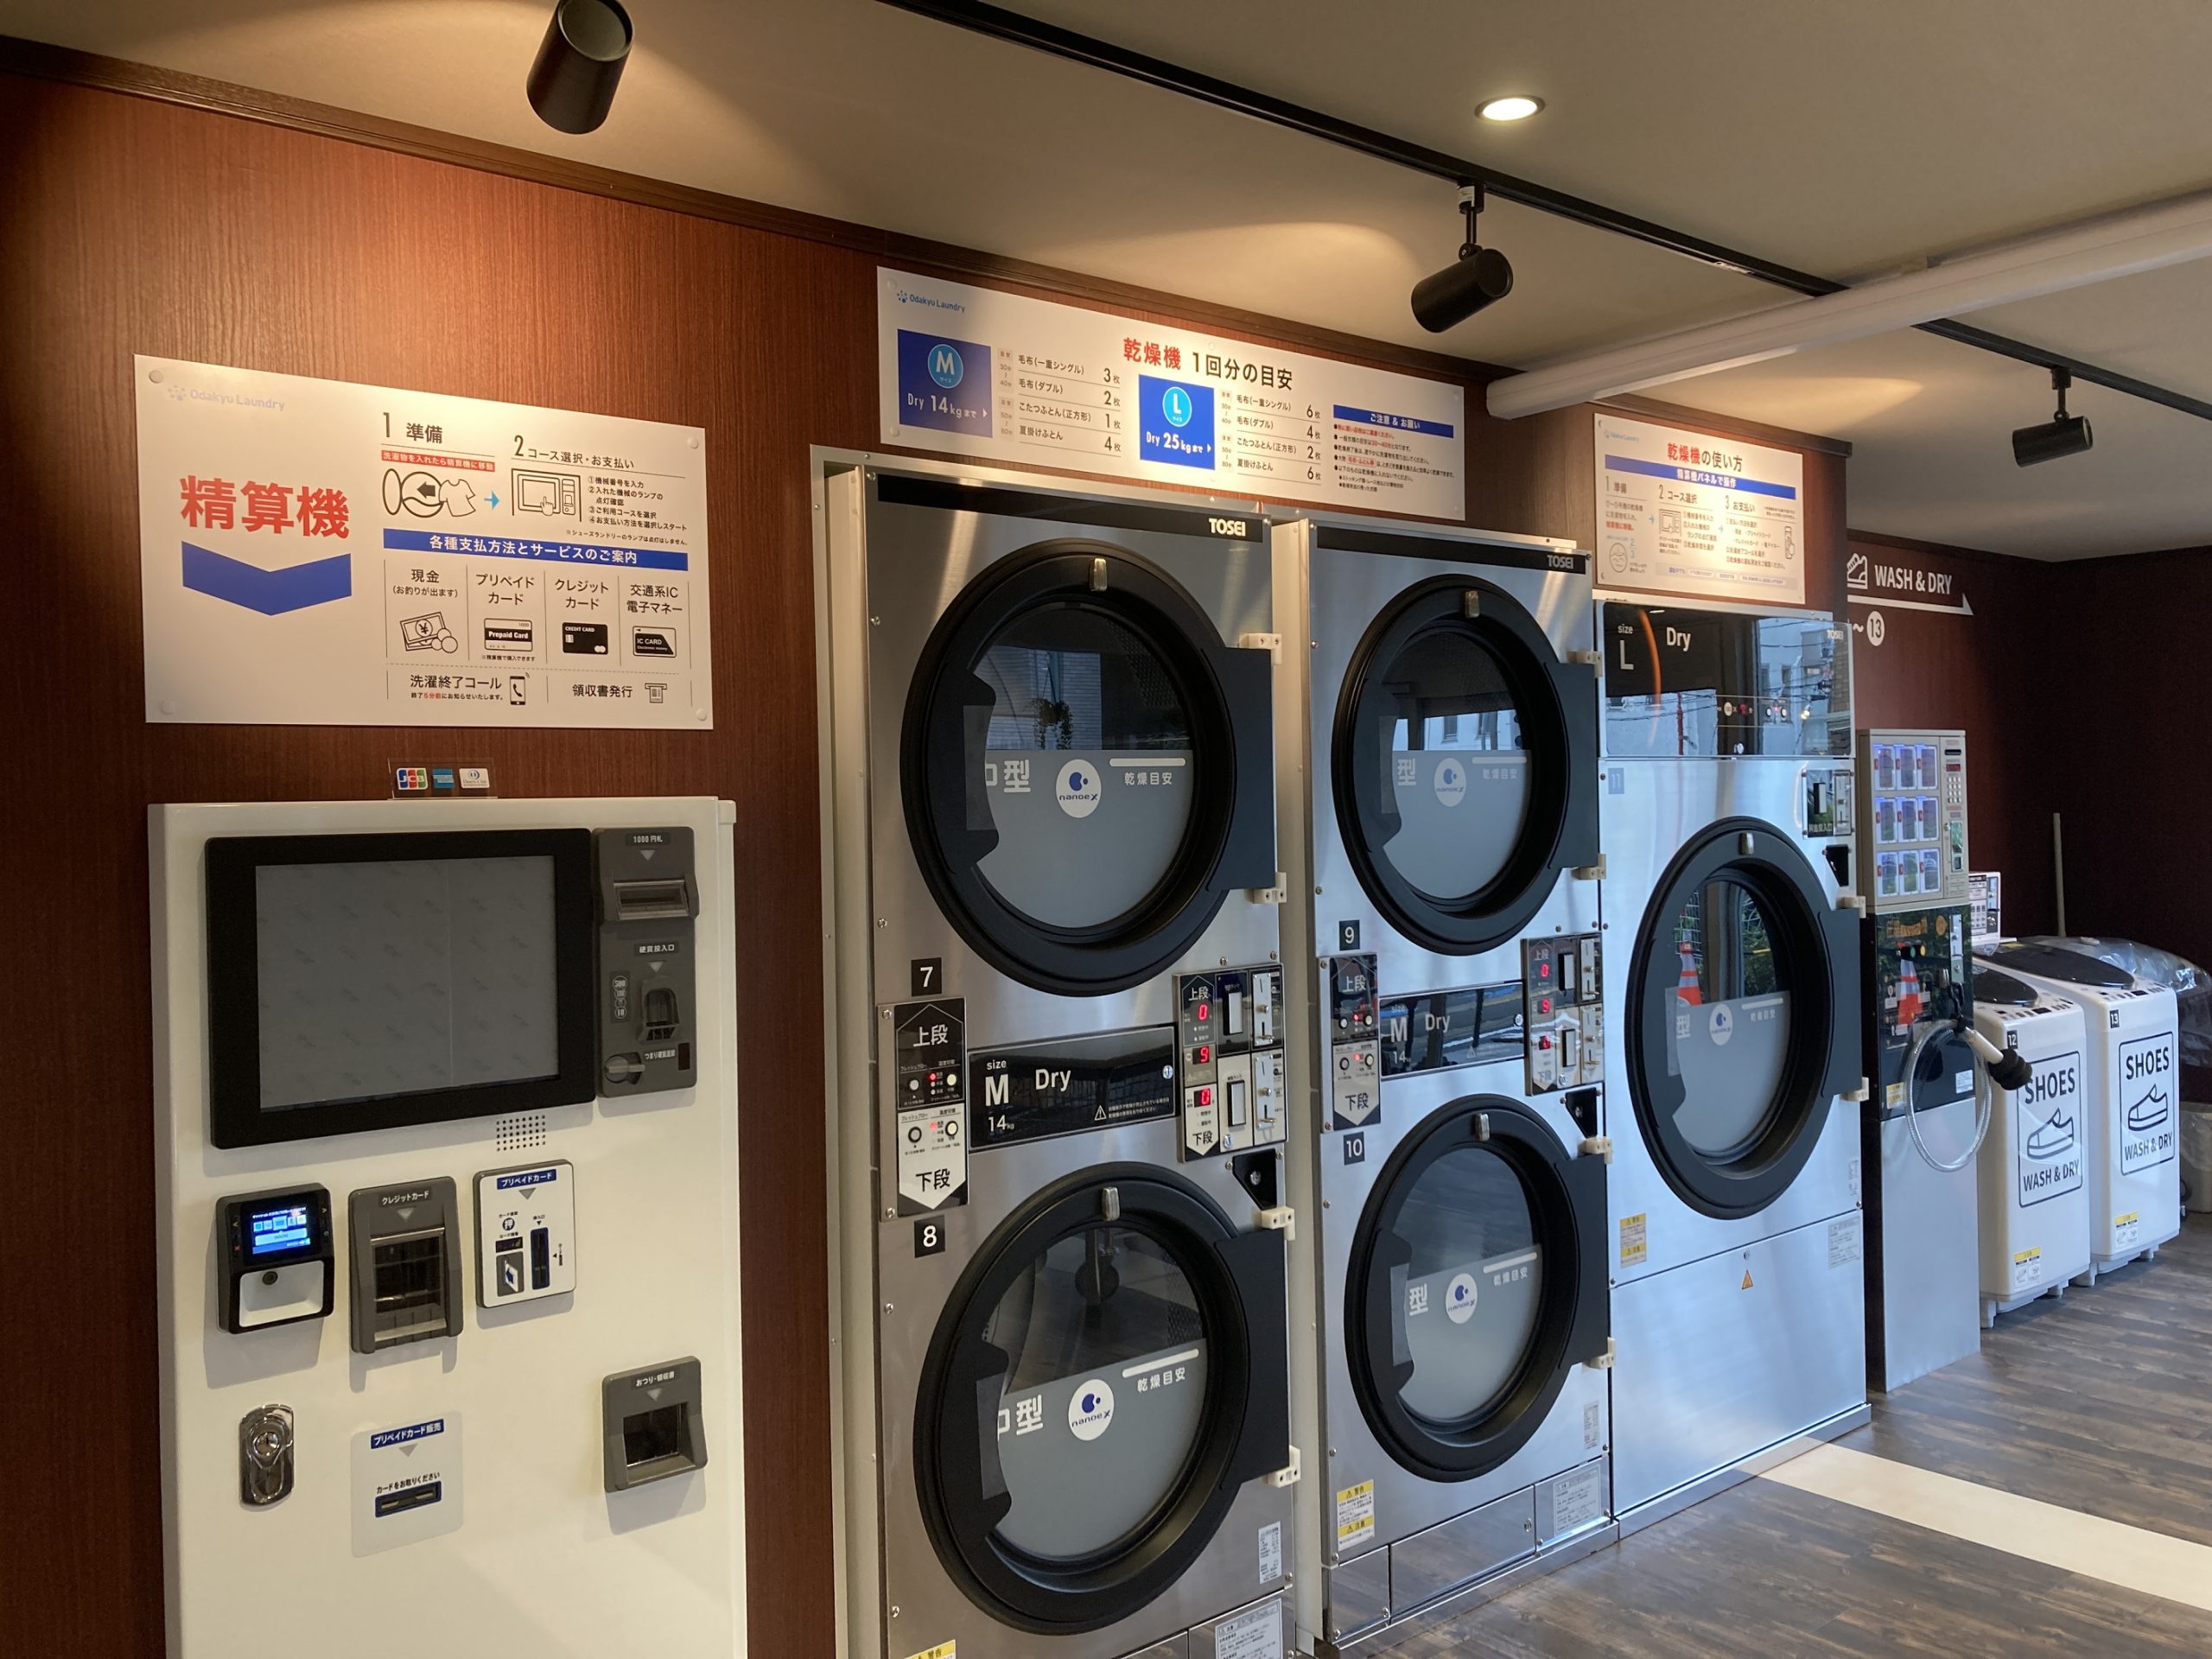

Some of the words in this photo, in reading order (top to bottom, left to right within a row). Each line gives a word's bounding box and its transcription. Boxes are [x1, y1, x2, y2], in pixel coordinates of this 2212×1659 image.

[909, 293, 936, 308] Odakyu
[936, 298, 966, 314] Laundry
[936, 350, 955, 376] M
[1018, 354, 1084, 376] 毛布(一重シングル)
[1122, 337, 1181, 371] 乾燥機
[1192, 351, 1294, 391] 1回分の目安
[1018, 378, 1064, 395] 毛布(ダブル)
[190, 388, 234, 405] Odakyu
[236, 394, 286, 411] Laundry
[907, 392, 925, 410] Dry
[1173, 392, 1182, 415] L
[1236, 393, 1292, 413] 毛布(一重シングル)
[1019, 402, 1091, 423] こたつふとん(正方形)
[1370, 412, 1390, 426] ご注意
[383, 412, 391, 438] 1
[406, 422, 443, 444] 準備
[1236, 416, 1274, 430] 毛布(ダブル)
[1019, 425, 1064, 442] 夏掛けふとん
[1146, 431, 1160, 448] Dry
[514, 435, 524, 457] 2
[527, 448, 635, 469] コース選択・お支払い
[1667, 442, 1743, 473] 乾燥機の使い方
[383, 451, 495, 472] 洗濯物を入れたら精算機に移動
[1236, 458, 1274, 473] 夏掛けふとん
[179, 474, 350, 539] 精算機
[595, 496, 625, 507] 点灯確認
[1668, 490, 1698, 505] コース選択
[1209, 518, 1247, 537] TOSEI
[429, 534, 638, 564] 各種支払方法とサービスのご案内
[1547, 554, 1574, 569] TOSEI
[410, 569, 440, 583] 現金
[475, 573, 535, 589] プリペイド
[1874, 564, 1913, 590] WASH
[1915, 570, 1926, 592] &
[1928, 572, 1952, 594] DRY
[391, 584, 459, 598] (お釣りが出ます)
[555, 578, 609, 594] クレジット
[630, 584, 679, 599] 交通系IC
[488, 592, 524, 606] カード
[565, 597, 601, 610] カード
[626, 600, 683, 614] 電子マネー
[488, 630, 515, 639] Prepaid
[517, 631, 529, 639] Card
[1618, 623, 1634, 635] size
[1870, 618, 1882, 639] 13
[1666, 626, 1691, 652] Dry
[1618, 639, 1635, 671] L
[410, 674, 502, 690] 洗濯終了コール
[572, 683, 633, 698] 領収書発行
[1123, 771, 1173, 785] 乾燥目安
[1344, 927, 1355, 945] 9
[639, 944, 675, 954] 硬貨投入口
[1534, 949, 1549, 962] 上段
[919, 965, 933, 988] 7
[1342, 974, 1367, 994] 上段
[1188, 986, 1210, 1002] 上段
[1198, 1004, 1208, 1021] 0
[1541, 998, 1550, 1014] 9
[1389, 1016, 1408, 1043] M
[1424, 1013, 1451, 1033] Dry
[2110, 1012, 2120, 1026] 13
[912, 1024, 949, 1049] 上段
[2008, 1032, 2017, 1047] 12
[1200, 1046, 1208, 1063] 9
[2126, 1046, 2170, 1080] SHOES
[986, 1058, 1007, 1071] size
[985, 1073, 1009, 1107] M
[1035, 1068, 1071, 1092] Dry
[2024, 1067, 2075, 1104] SHOES
[1201, 1088, 1210, 1105] 0
[1344, 1092, 1370, 1112] 下段
[1192, 1130, 1213, 1146] 下段
[2125, 1142, 2150, 1161] WASH
[2151, 1139, 2157, 1153] &
[2158, 1132, 2173, 1150] DRY
[1345, 1139, 1363, 1158] 10
[501, 1172, 552, 1187] プリペイドカード
[915, 1169, 951, 1192] 下段
[2023, 1168, 2051, 1192] WASH
[2054, 1166, 2061, 1182] &
[2063, 1159, 2080, 1179] DRY
[382, 1190, 429, 1205] クレジットカード
[922, 1225, 938, 1248] 8
[1136, 1367, 1185, 1393] 乾燥目安
[373, 1421, 442, 1446] プリペイドカード販売
[376, 1471, 440, 1494] カードをお取りください
